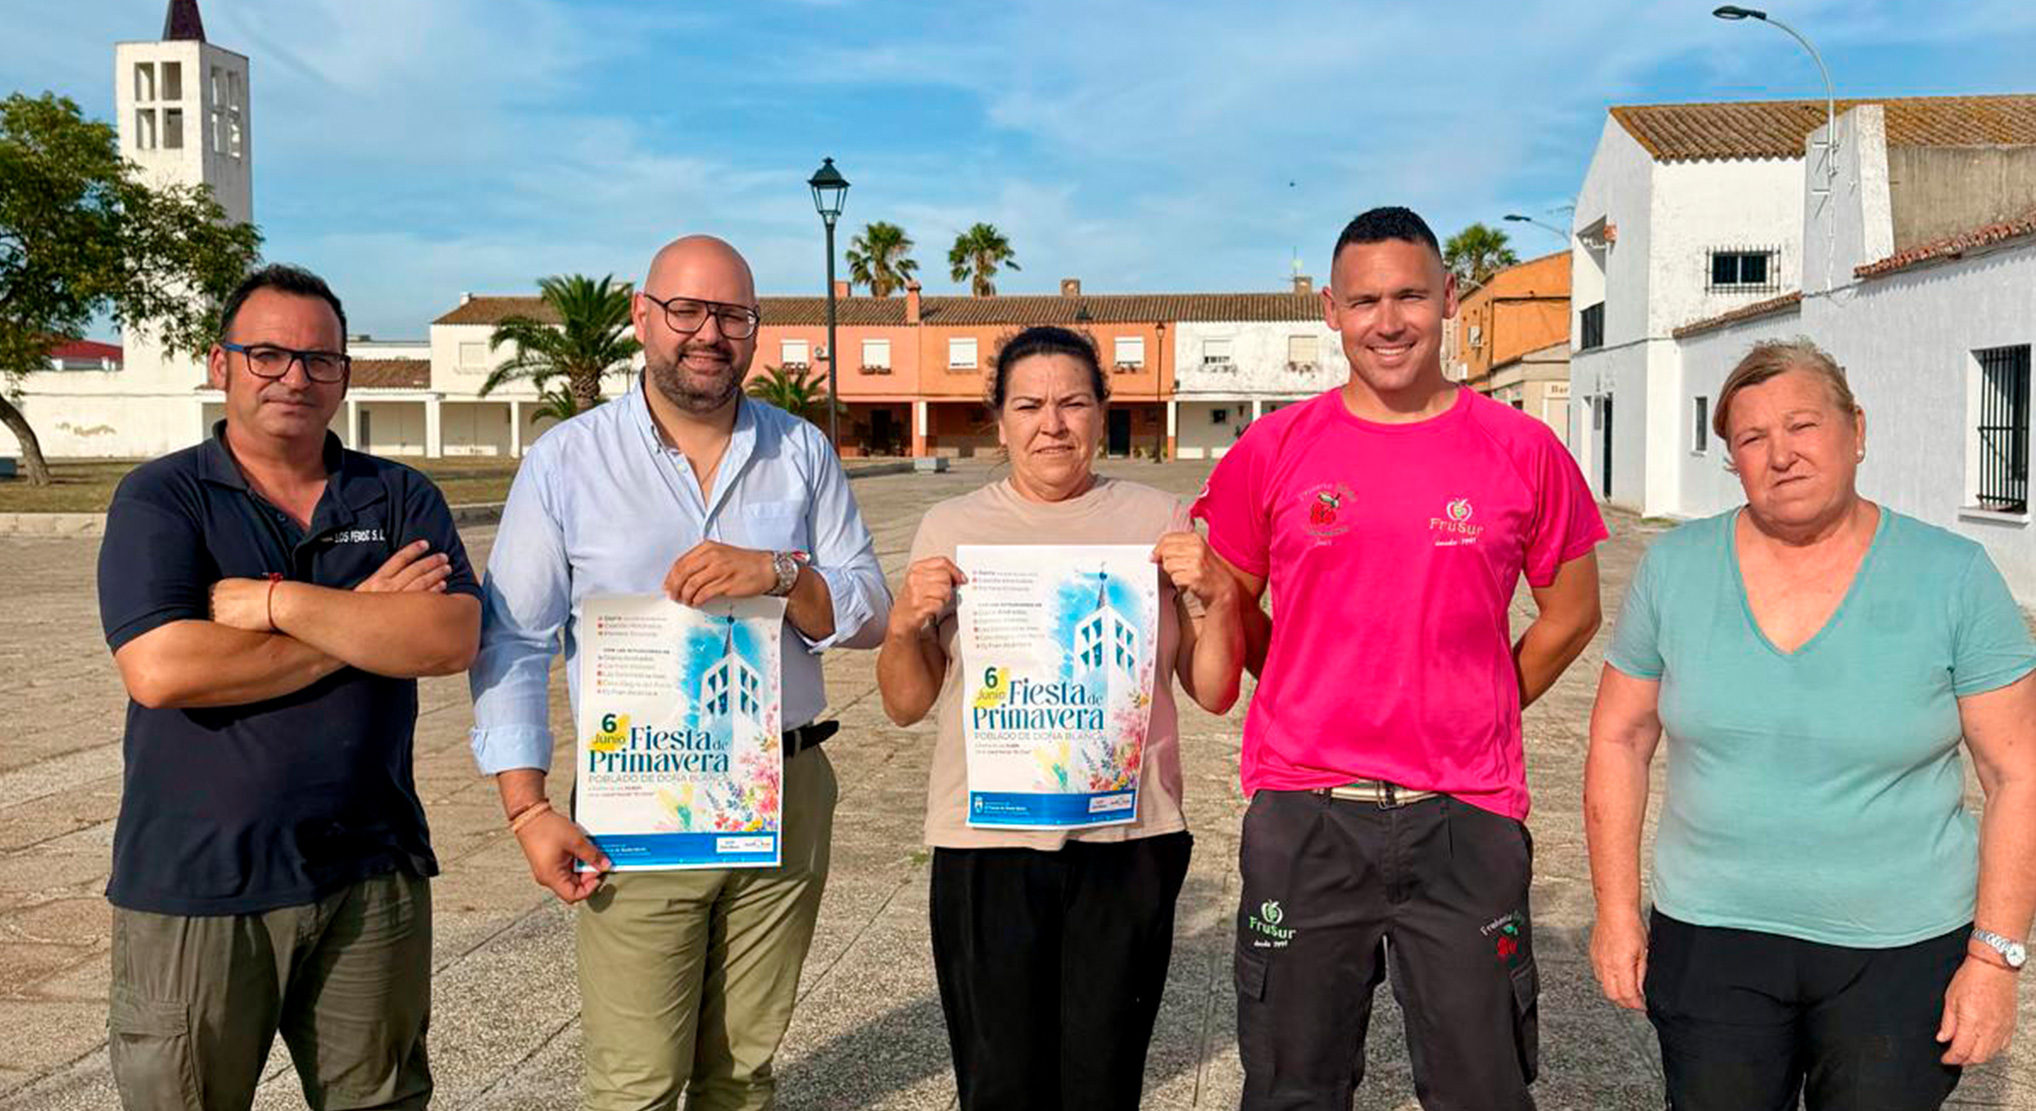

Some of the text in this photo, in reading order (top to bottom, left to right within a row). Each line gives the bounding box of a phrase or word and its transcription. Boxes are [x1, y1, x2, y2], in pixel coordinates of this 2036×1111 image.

[334, 531, 349, 543] LOS
[984, 666, 998, 689] 6
[977, 689, 1007, 701] Junio
[1009, 677, 1104, 706] Fiesta de
[602, 713, 617, 734] 6
[973, 703, 1105, 730] Primavera
[593, 734, 626, 745] Junio
[630, 725, 729, 751] Fiesta de
[974, 732, 1017, 741] POBLADO
[1018, 732, 1031, 741] DE
[1033, 731, 1063, 741] DOÑA
[589, 748, 729, 773] Primavera
[588, 774, 639, 784] POBLADO
[641, 774, 655, 784] DE
[657, 773, 687, 784] DOÑA
